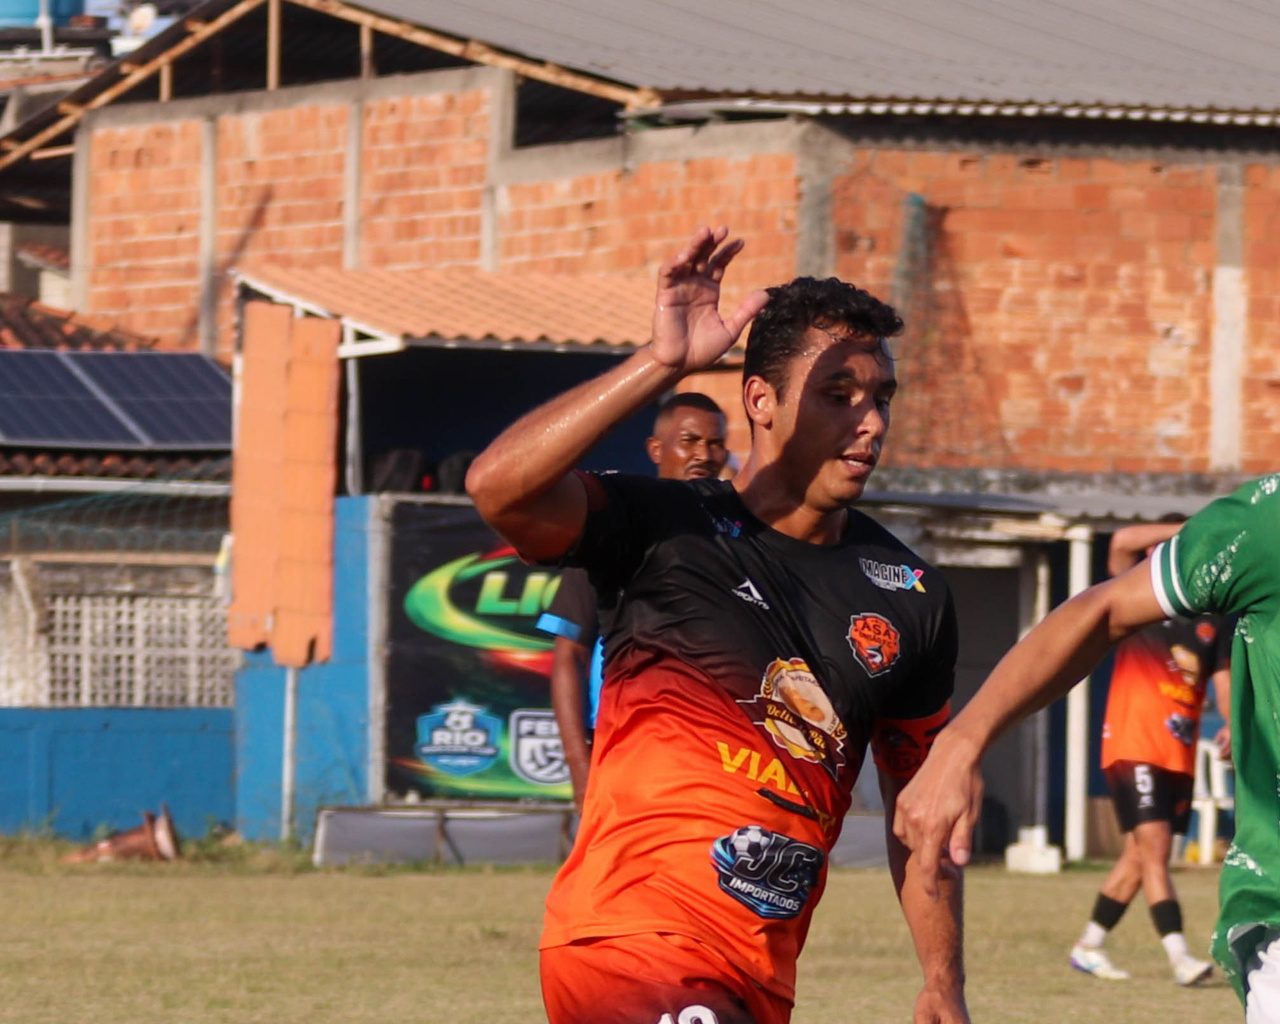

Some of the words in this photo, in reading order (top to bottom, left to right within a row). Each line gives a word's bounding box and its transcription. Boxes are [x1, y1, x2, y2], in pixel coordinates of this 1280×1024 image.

[861, 621, 892, 641] ASA
[432, 730, 487, 747] RIO
[1134, 765, 1154, 793] 5
[732, 832, 818, 893] JC
[729, 877, 801, 911] IMPORTADOS
